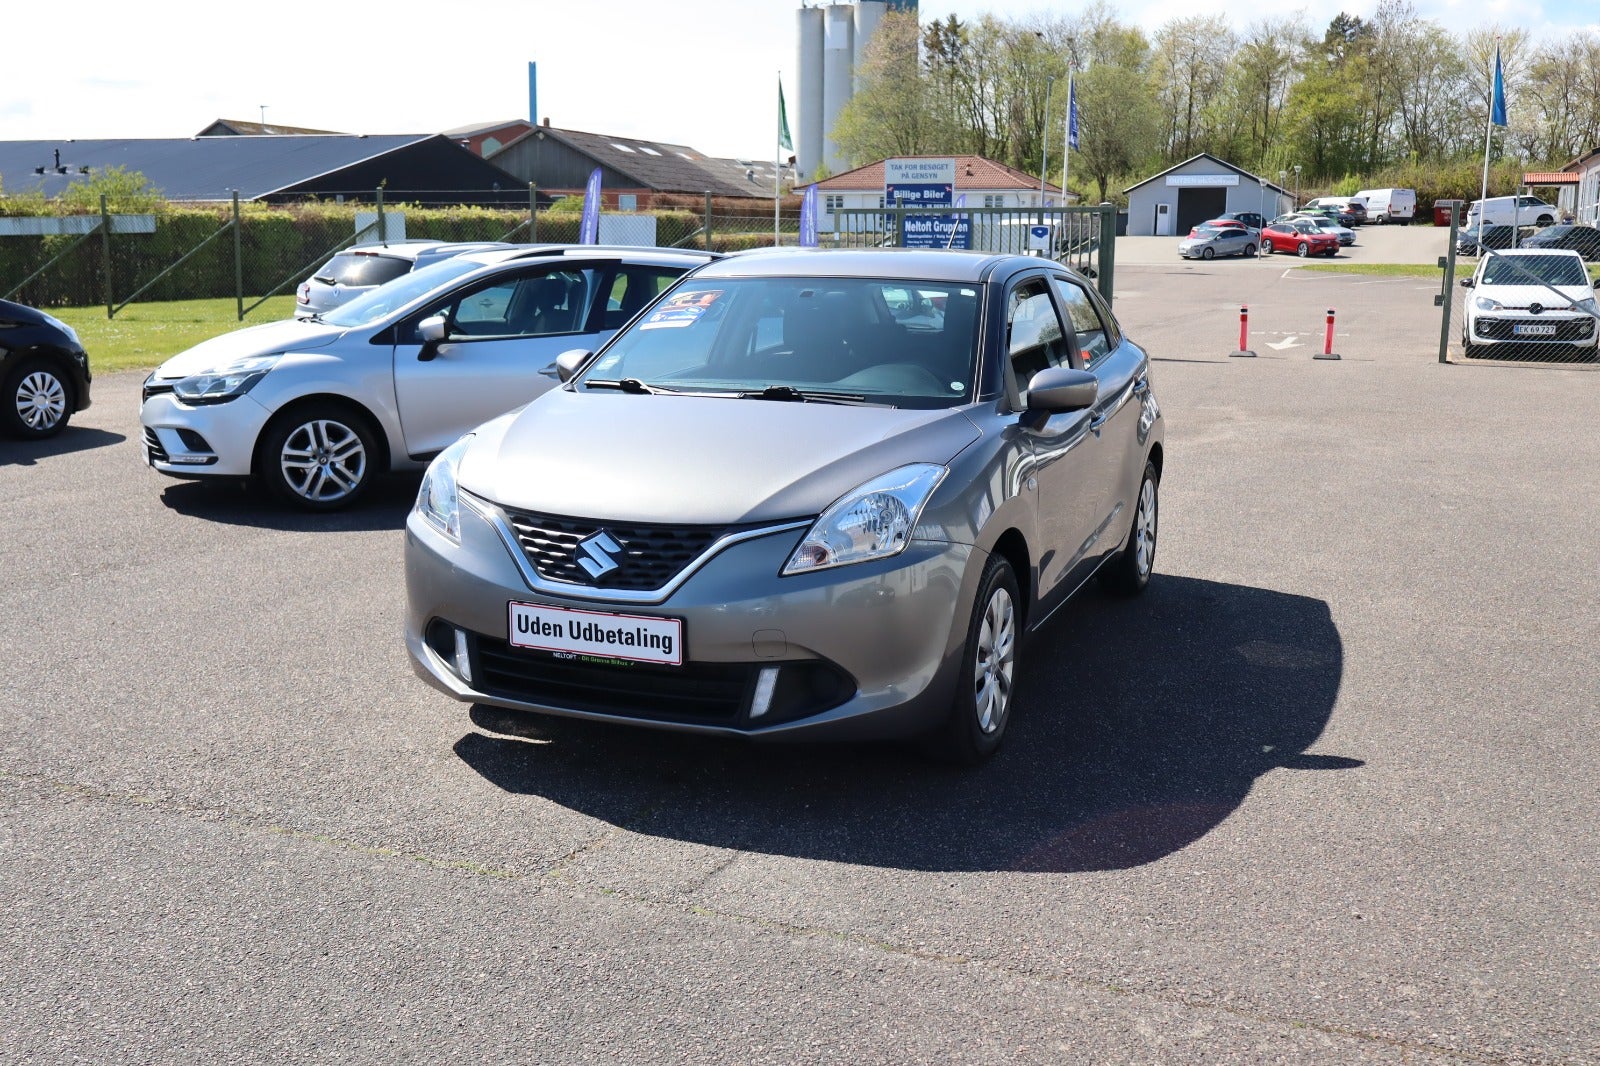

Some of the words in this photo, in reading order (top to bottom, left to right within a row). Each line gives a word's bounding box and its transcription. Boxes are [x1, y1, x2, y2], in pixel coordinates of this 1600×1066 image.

[894, 190, 921, 200] Billige
[924, 190, 945, 199] Biler
[905, 221, 932, 232] Neltoft
[1541, 326, 1555, 334] 727
[517, 613, 563, 638] Uden
[568, 620, 673, 655] Udbetaling
